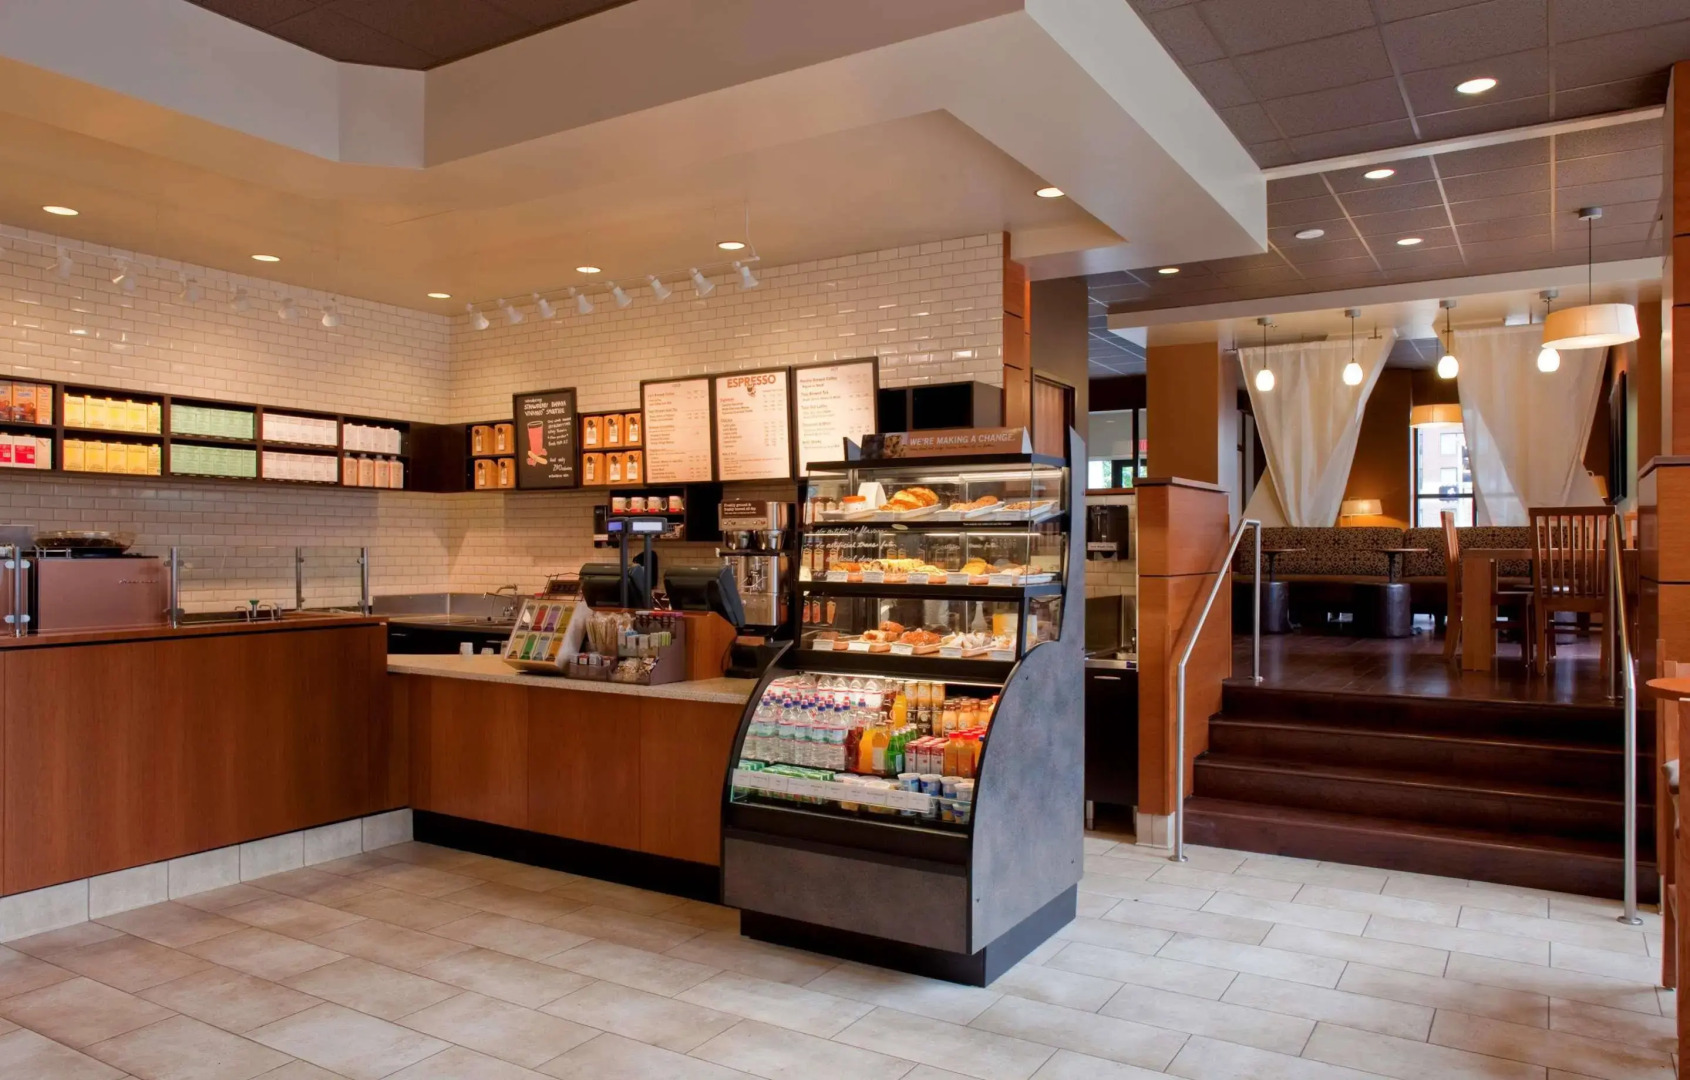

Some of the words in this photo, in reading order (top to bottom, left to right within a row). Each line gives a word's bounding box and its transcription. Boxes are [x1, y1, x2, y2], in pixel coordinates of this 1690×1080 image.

[727, 374, 776, 388] ESPRESSO
[910, 437, 935, 446] WE'RE
[936, 435, 969, 445] MAKING
[970, 435, 977, 443] A
